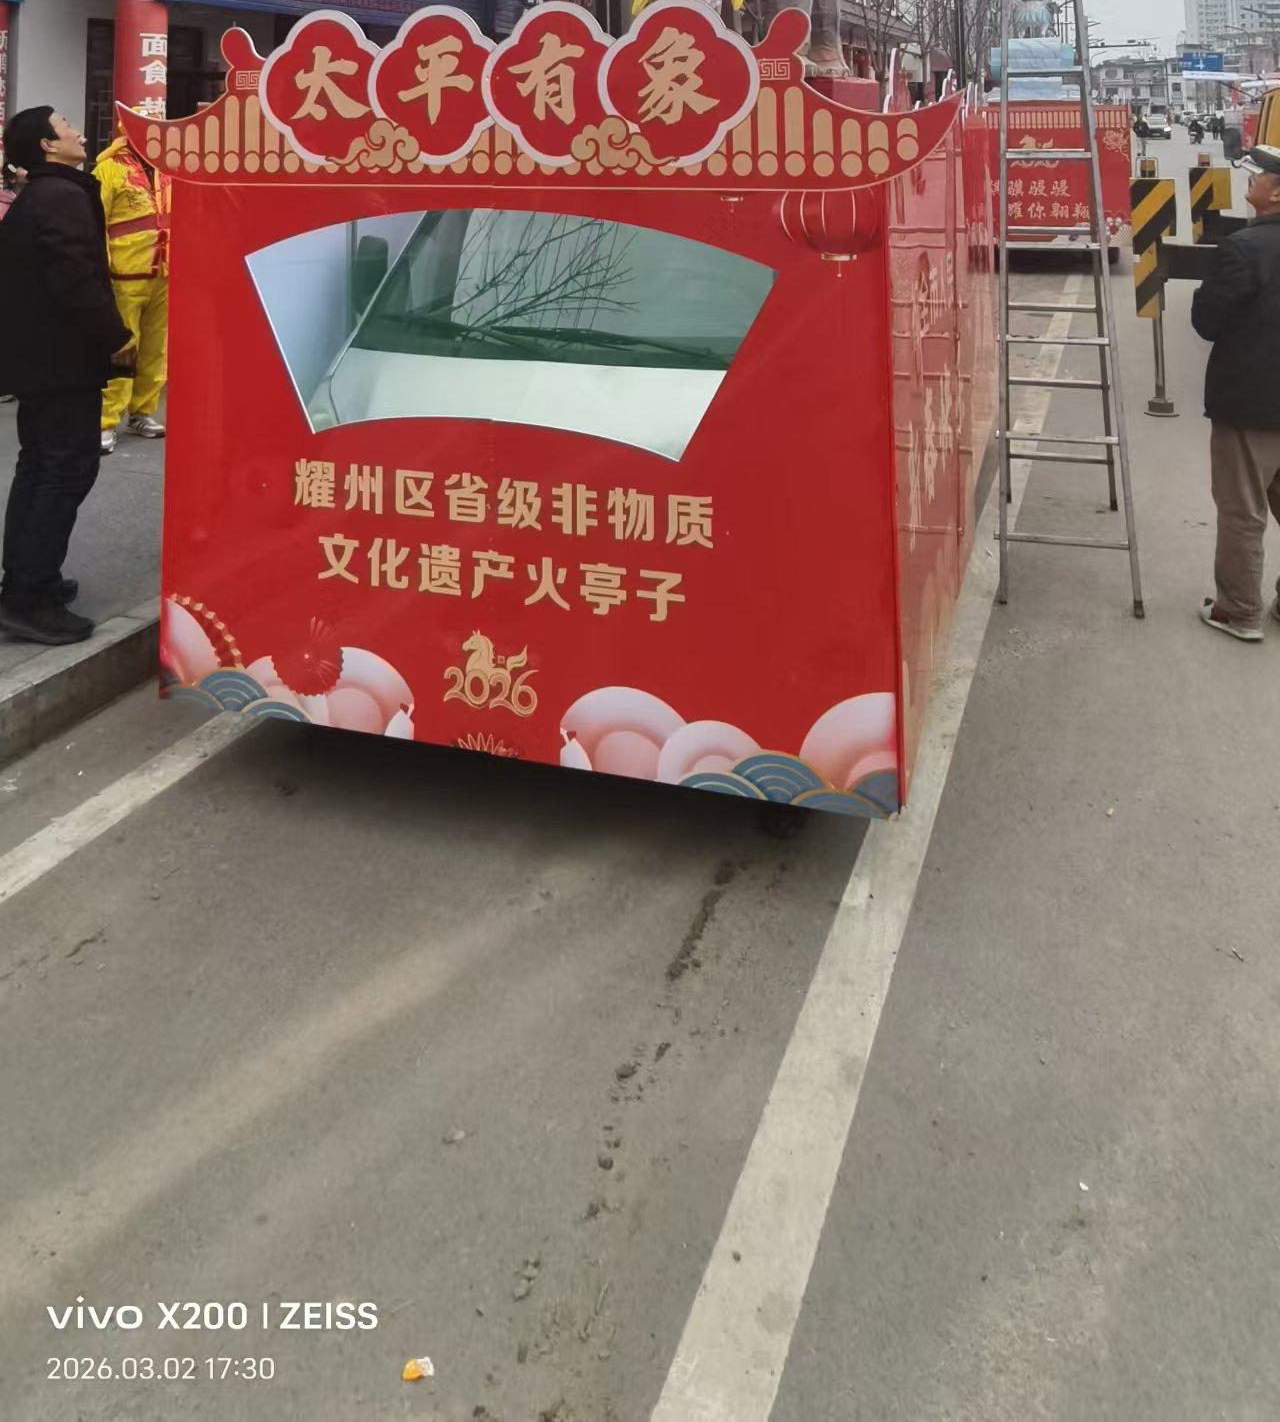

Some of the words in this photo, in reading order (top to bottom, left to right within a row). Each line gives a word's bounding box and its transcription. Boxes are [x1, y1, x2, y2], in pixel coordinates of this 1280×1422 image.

[291, 26, 721, 126] 太平有象
[294, 458, 715, 549] 耀州区省级非物质
[317, 533, 686, 622] 文化遗产火亭子
[443, 666, 539, 717] 2026
